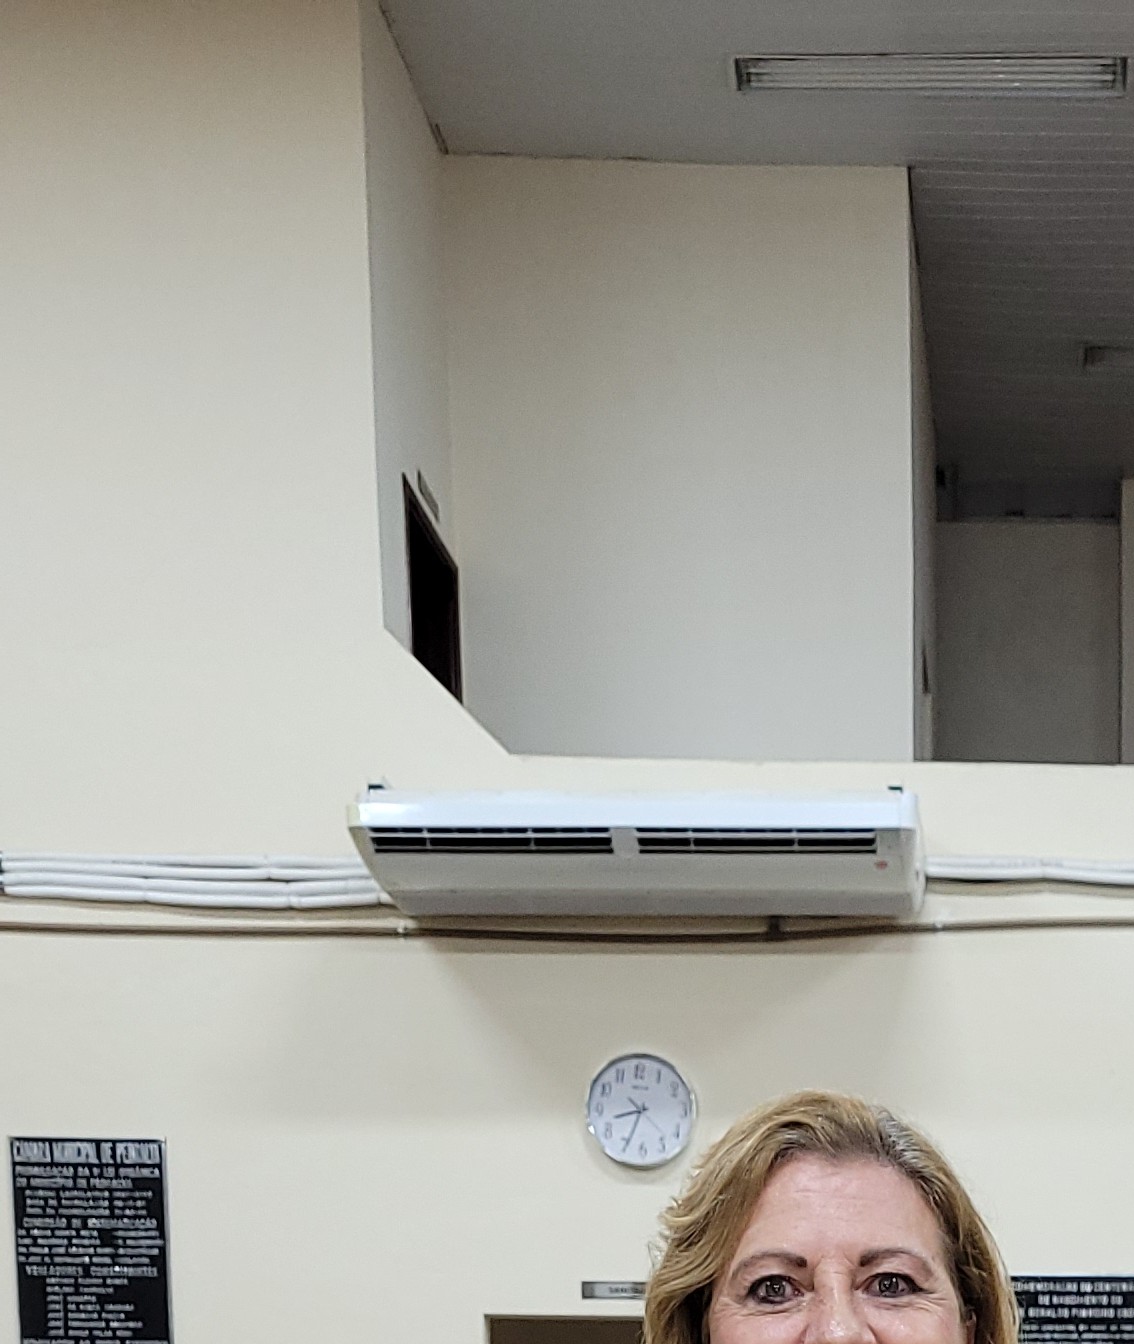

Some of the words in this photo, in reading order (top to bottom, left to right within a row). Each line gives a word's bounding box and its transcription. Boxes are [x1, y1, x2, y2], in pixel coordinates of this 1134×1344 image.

[615, 1068, 625, 1084] 11
[633, 1062, 646, 1080] 12
[600, 1081, 612, 1098] 10
[604, 1121, 613, 1140] 8
[639, 1142, 648, 1159] 6
